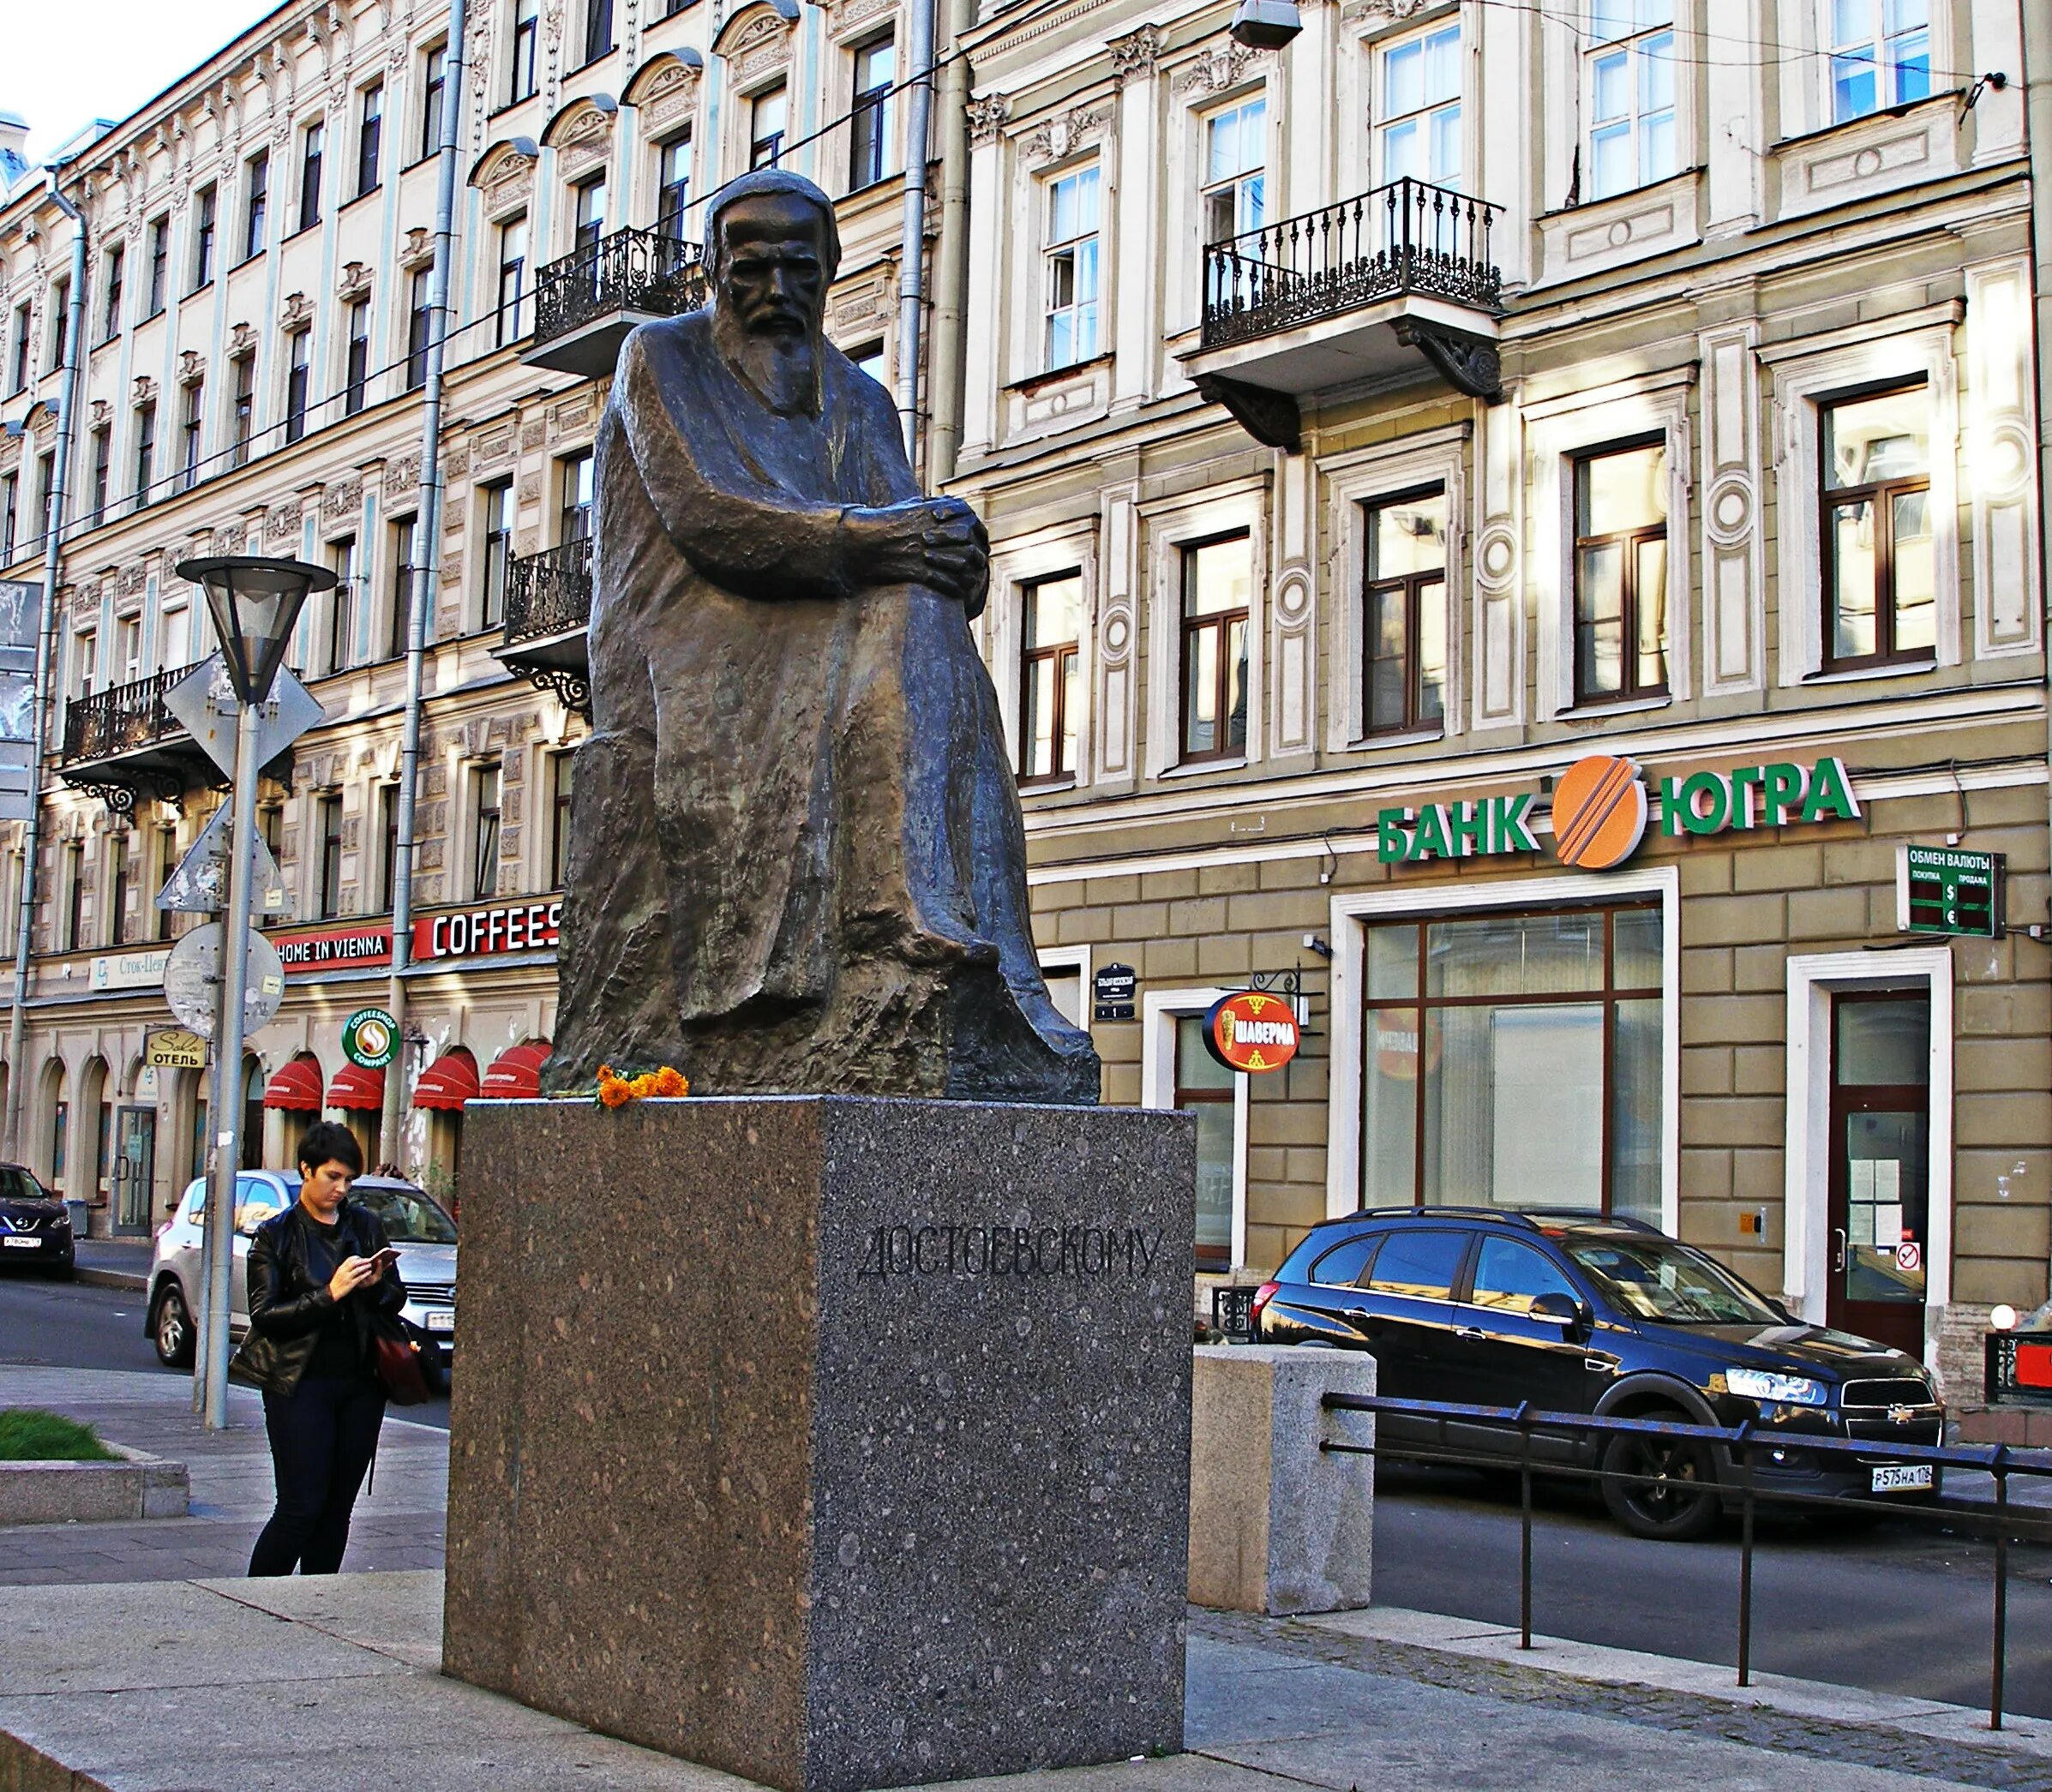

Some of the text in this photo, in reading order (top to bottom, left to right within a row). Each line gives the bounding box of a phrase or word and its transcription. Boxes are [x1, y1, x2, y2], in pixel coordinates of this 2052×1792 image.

[1378, 758, 1860, 863] БАНК ЮГРА
[1910, 849, 1989, 870] ОБМЕН ВАЛЮТЫ
[1912, 870, 1941, 881] ПОКУПКА
[1959, 874, 1987, 884] ПРОДАЖА
[1947, 884, 1954, 901] $
[1947, 910, 1954, 924] €
[278, 934, 383, 962] HOME IN VIENNA
[350, 1010, 396, 1029] COFFEESHOP
[150, 1031, 204, 1052] Solo
[1234, 1019, 1295, 1046] ШАВЕРМА
[154, 1053, 199, 1065] ОТЕЛЬ
[353, 1052, 391, 1067] COMPANY
[858, 1225, 1165, 1286] ДОСТОЕВСКОМУ
